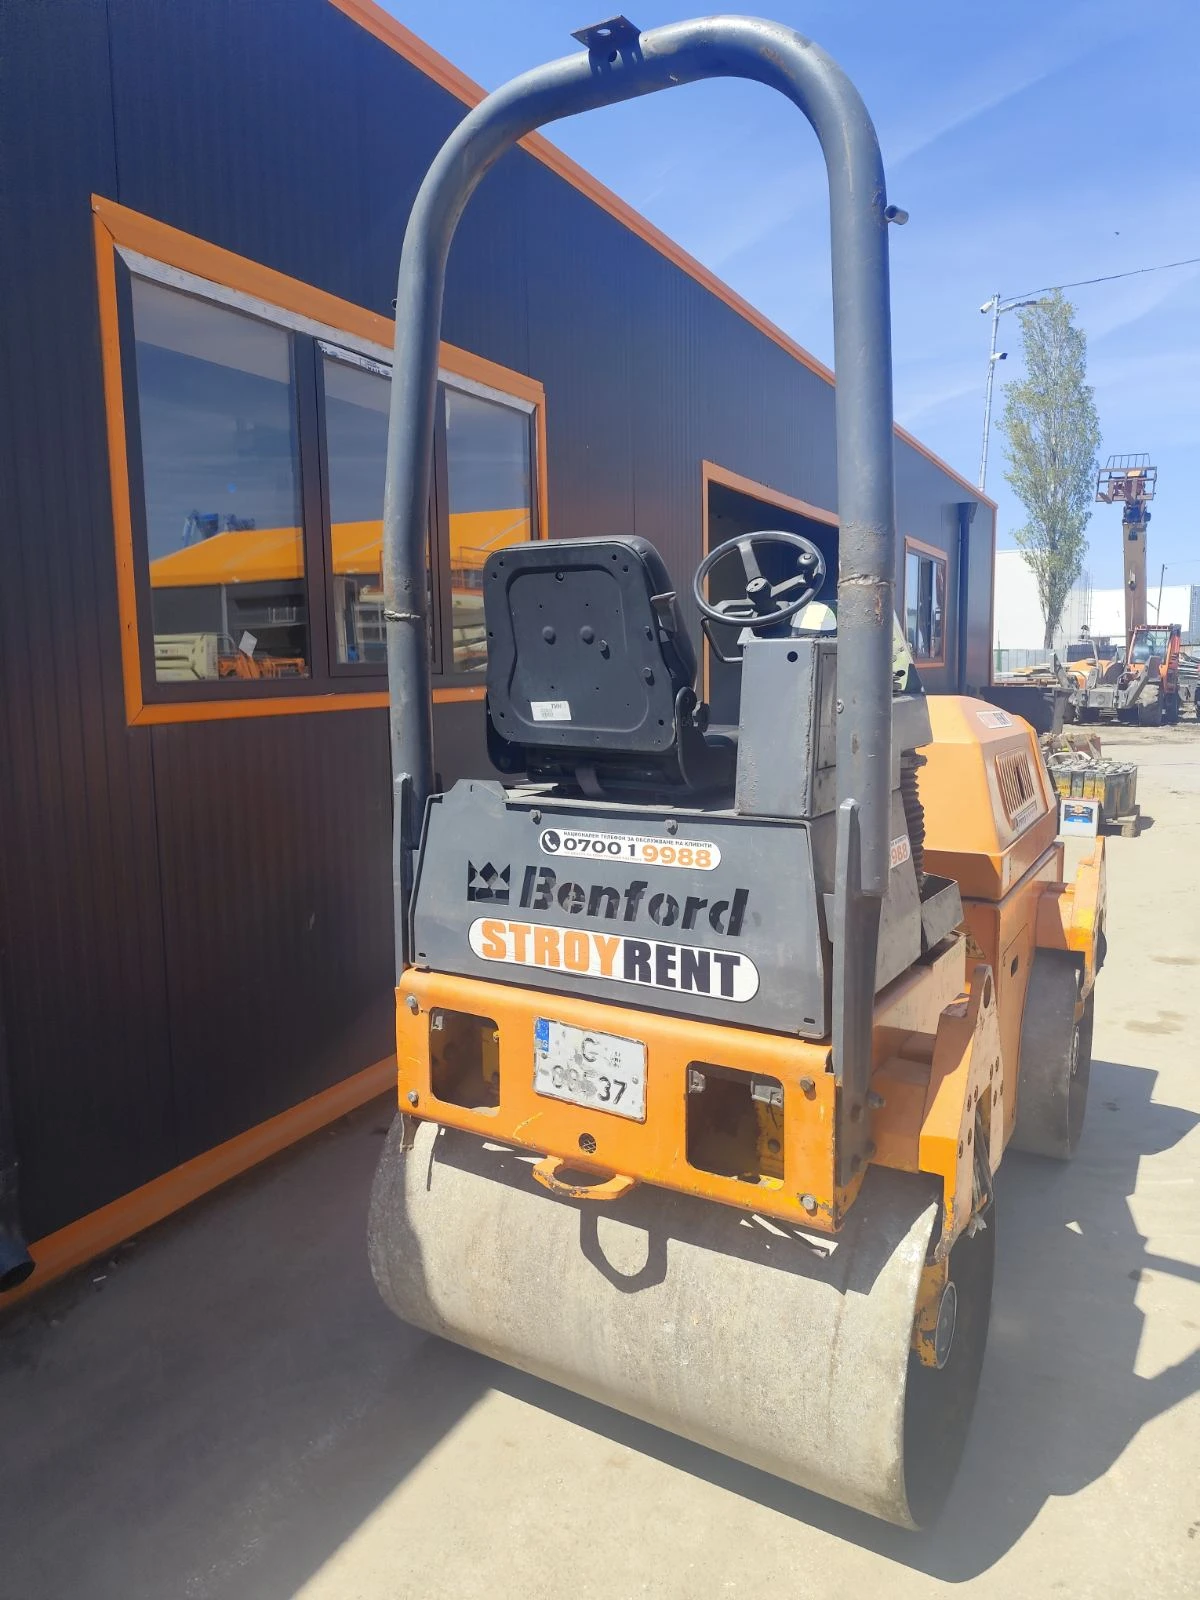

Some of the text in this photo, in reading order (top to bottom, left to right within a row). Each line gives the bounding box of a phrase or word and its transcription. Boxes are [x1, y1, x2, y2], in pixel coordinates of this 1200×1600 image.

[563, 831, 600, 839] НАЦИОНАЛЕН
[636, 837, 674, 846] ОБСЛУЖВАНЕ
[563, 838, 622, 855] 0700
[628, 843, 636, 857] 1
[642, 844, 712, 868] 9988
[519, 865, 750, 937] Benford
[481, 919, 741, 998] STROYRENT
